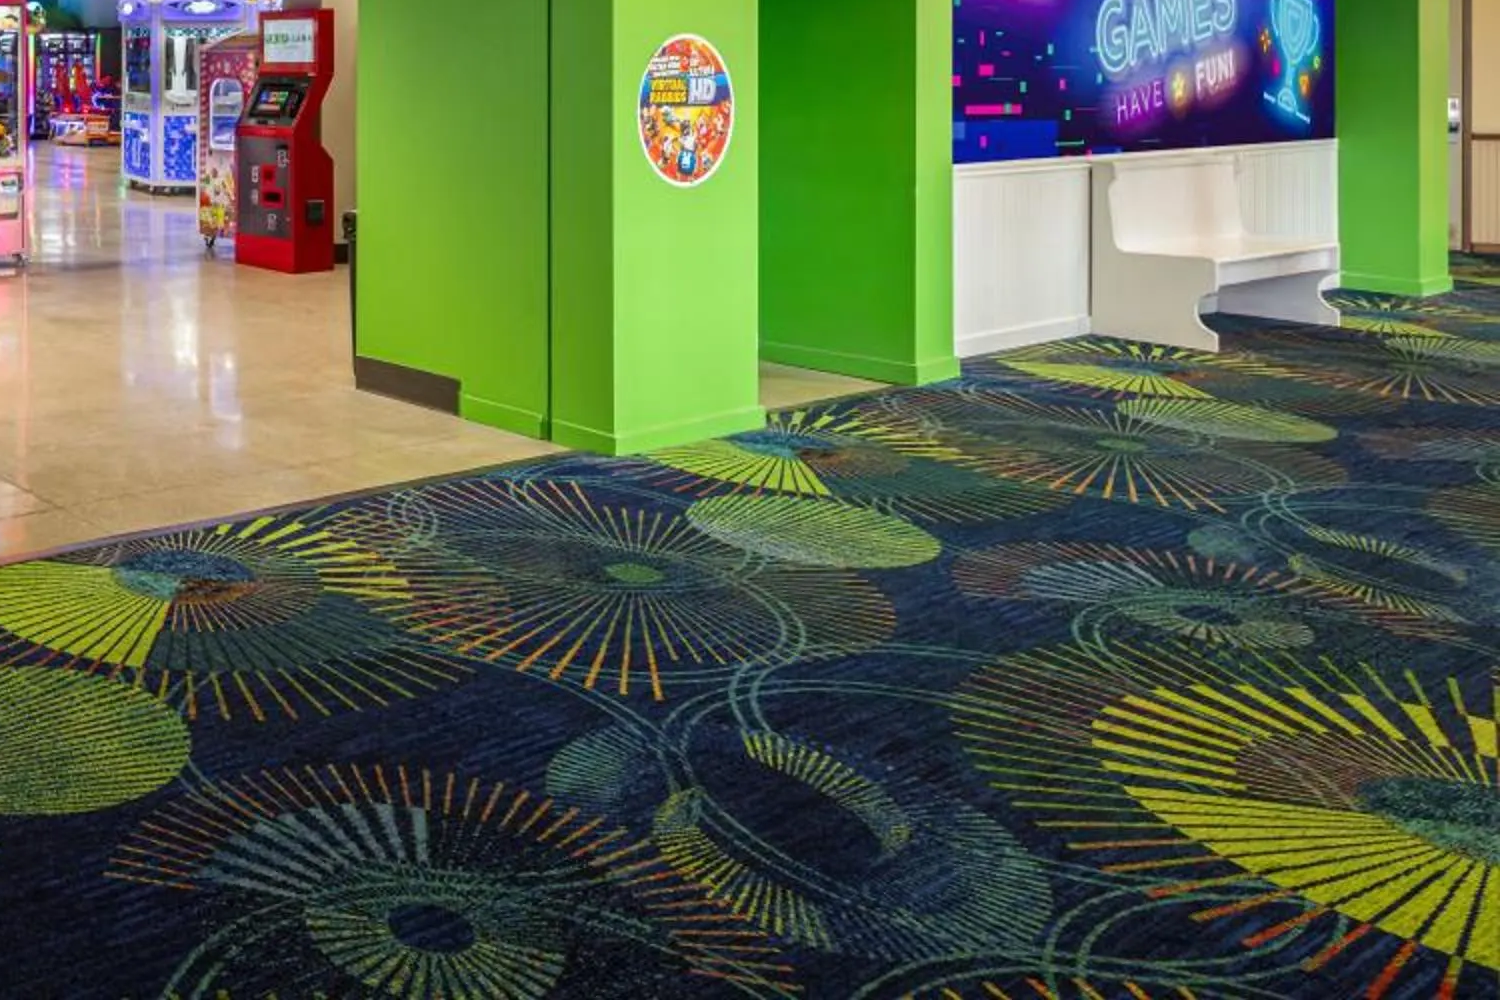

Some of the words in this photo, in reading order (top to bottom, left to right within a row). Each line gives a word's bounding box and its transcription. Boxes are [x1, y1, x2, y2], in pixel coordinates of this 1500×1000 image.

[688, 77, 717, 104] HD
[1116, 79, 1165, 124] HAVE
[1194, 50, 1236, 91] FUN!
